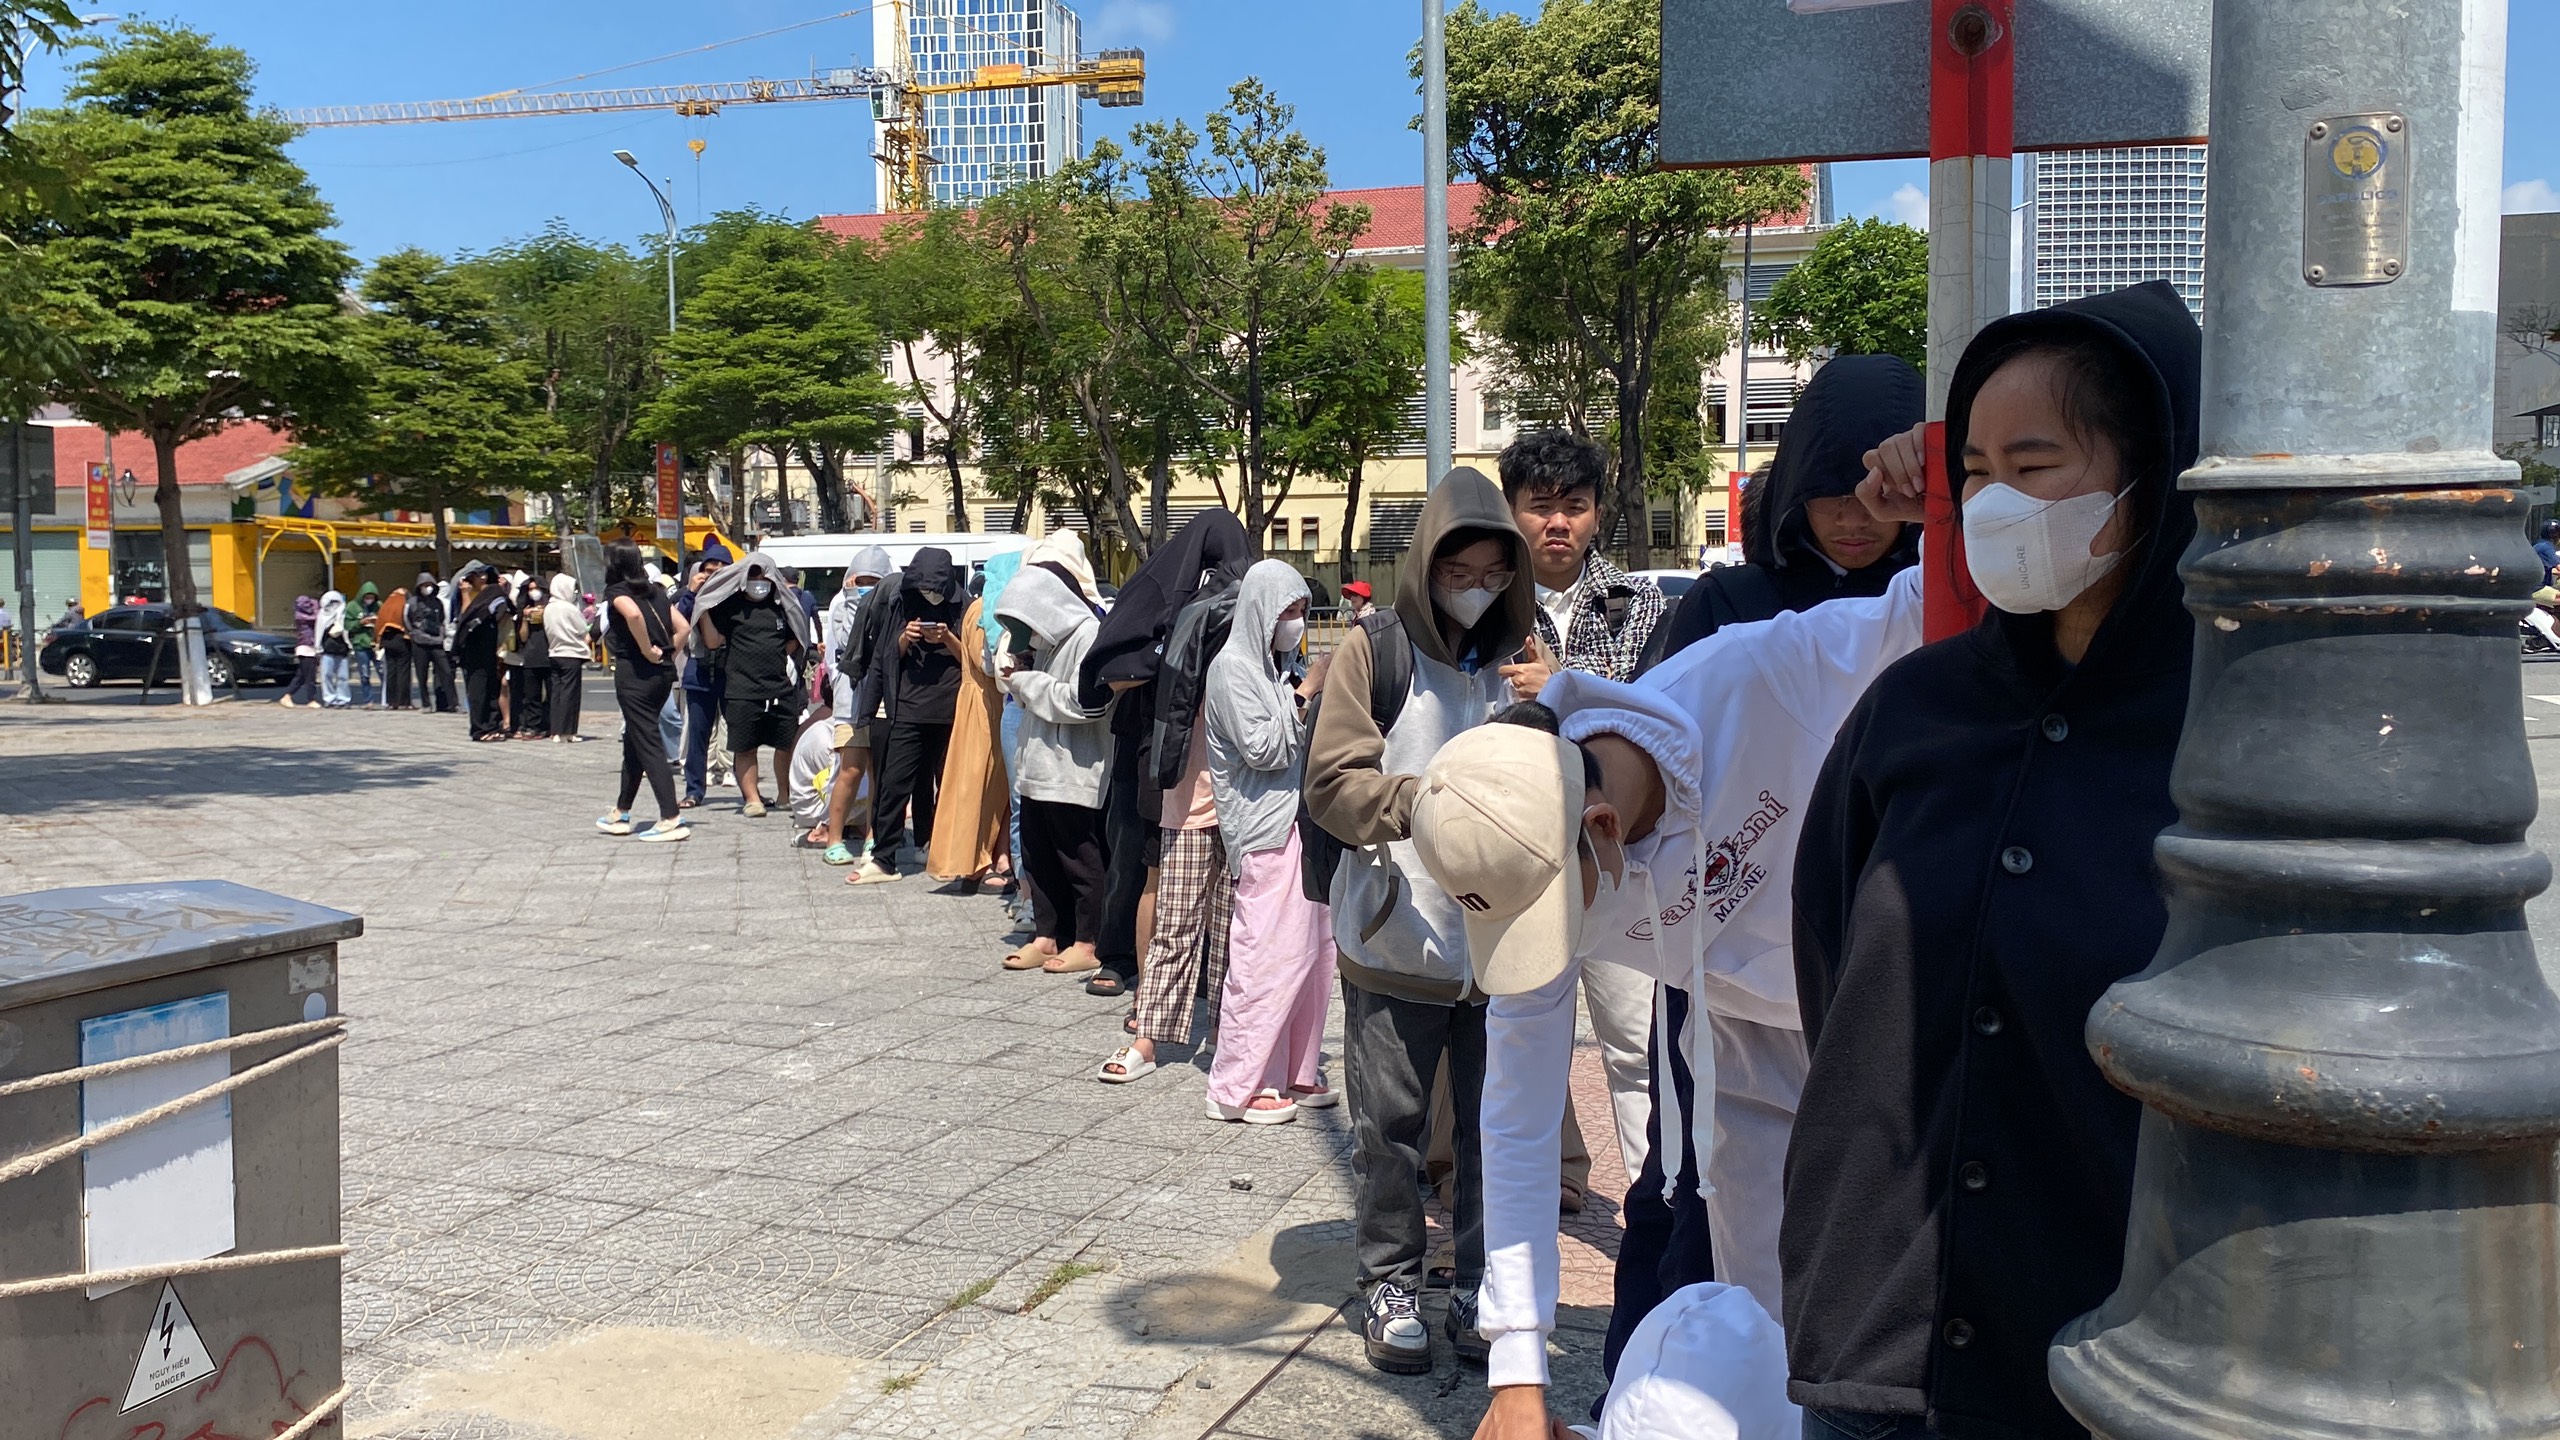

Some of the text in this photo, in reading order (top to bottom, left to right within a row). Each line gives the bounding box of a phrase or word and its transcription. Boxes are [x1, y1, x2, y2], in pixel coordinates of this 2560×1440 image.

[2016, 545, 2030, 590] UNICARE
[1713, 865, 1767, 924] MAGNE
[149, 1365, 170, 1381] NGUY
[154, 1370, 186, 1390] DANGER
